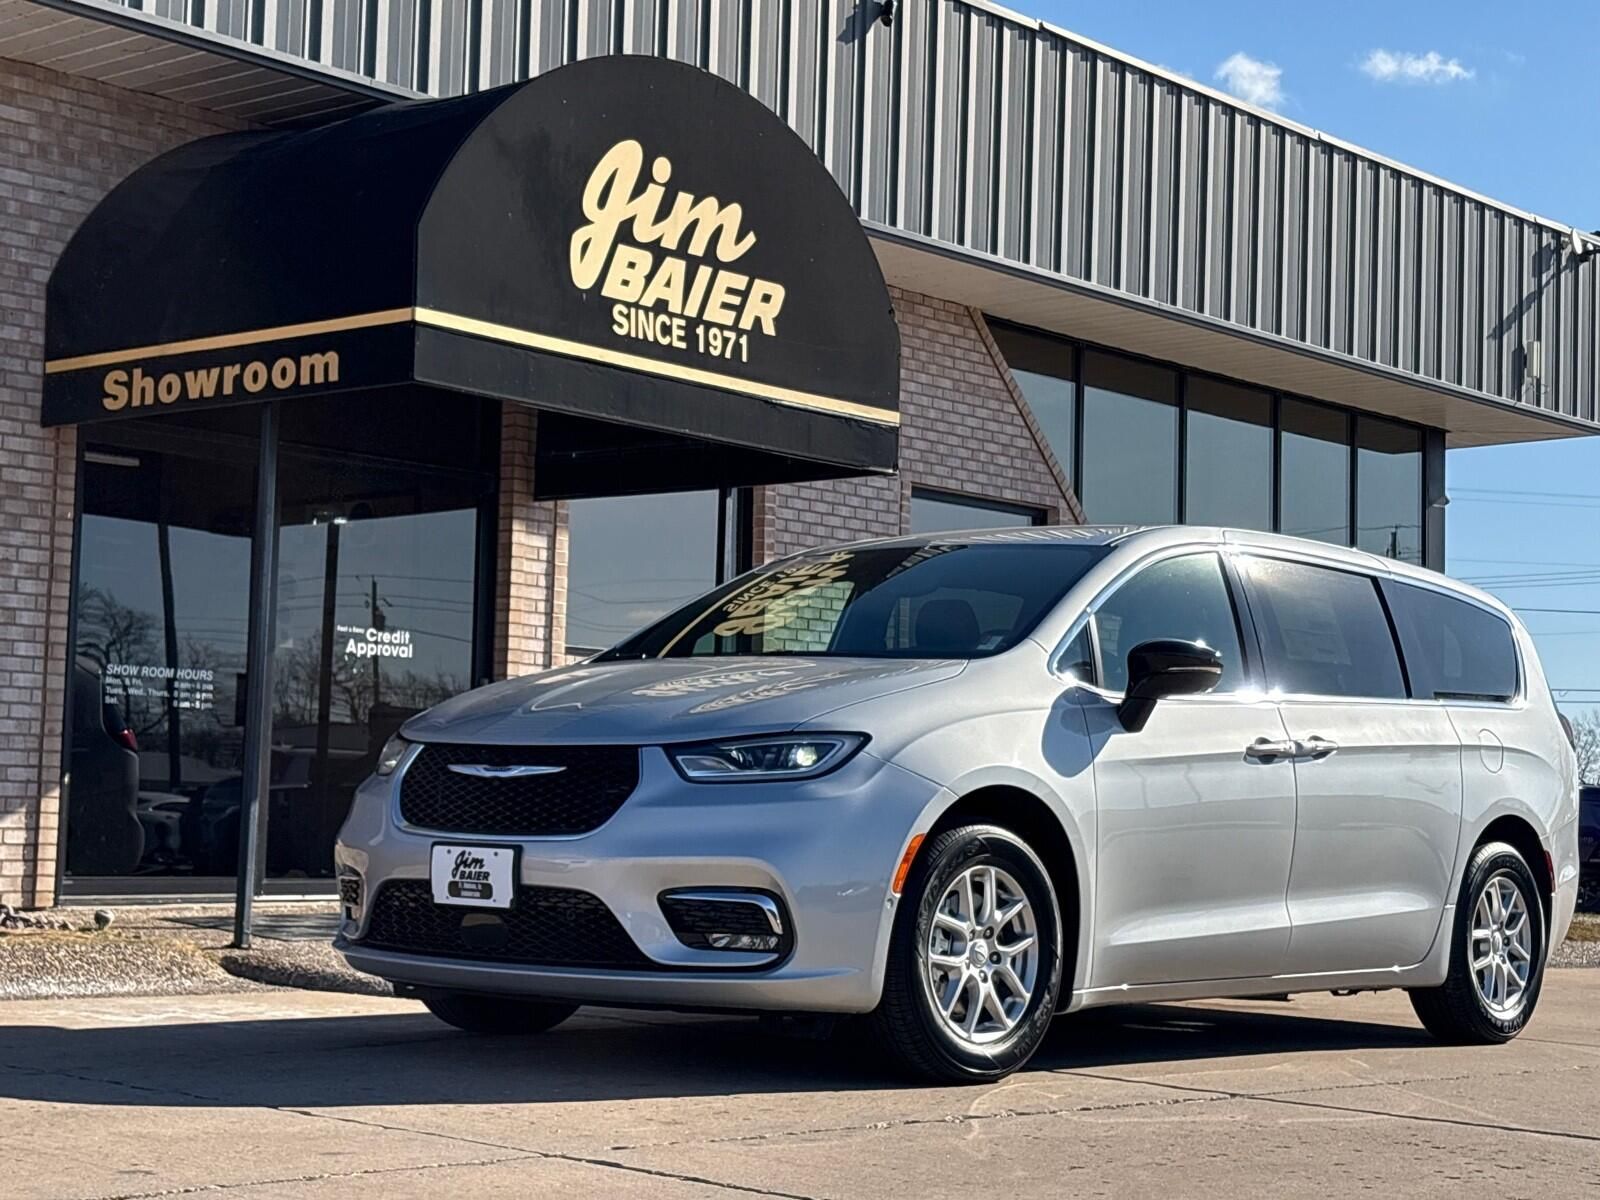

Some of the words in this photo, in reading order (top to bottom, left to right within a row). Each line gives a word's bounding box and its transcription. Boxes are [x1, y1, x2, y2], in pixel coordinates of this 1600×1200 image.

[570, 140, 757, 289] Jim
[600, 244, 785, 336] BAIER
[612, 304, 687, 349] SINCE
[696, 324, 748, 363] 1971
[102, 351, 339, 411] Showroom
[345, 638, 413, 658] Approval
[366, 628, 410, 644] Credit
[106, 664, 140, 676] SHOW
[141, 666, 174, 679] ROOM
[177, 669, 213, 681] HOURS
[452, 850, 485, 879] Jim
[459, 870, 490, 881] BAIER
